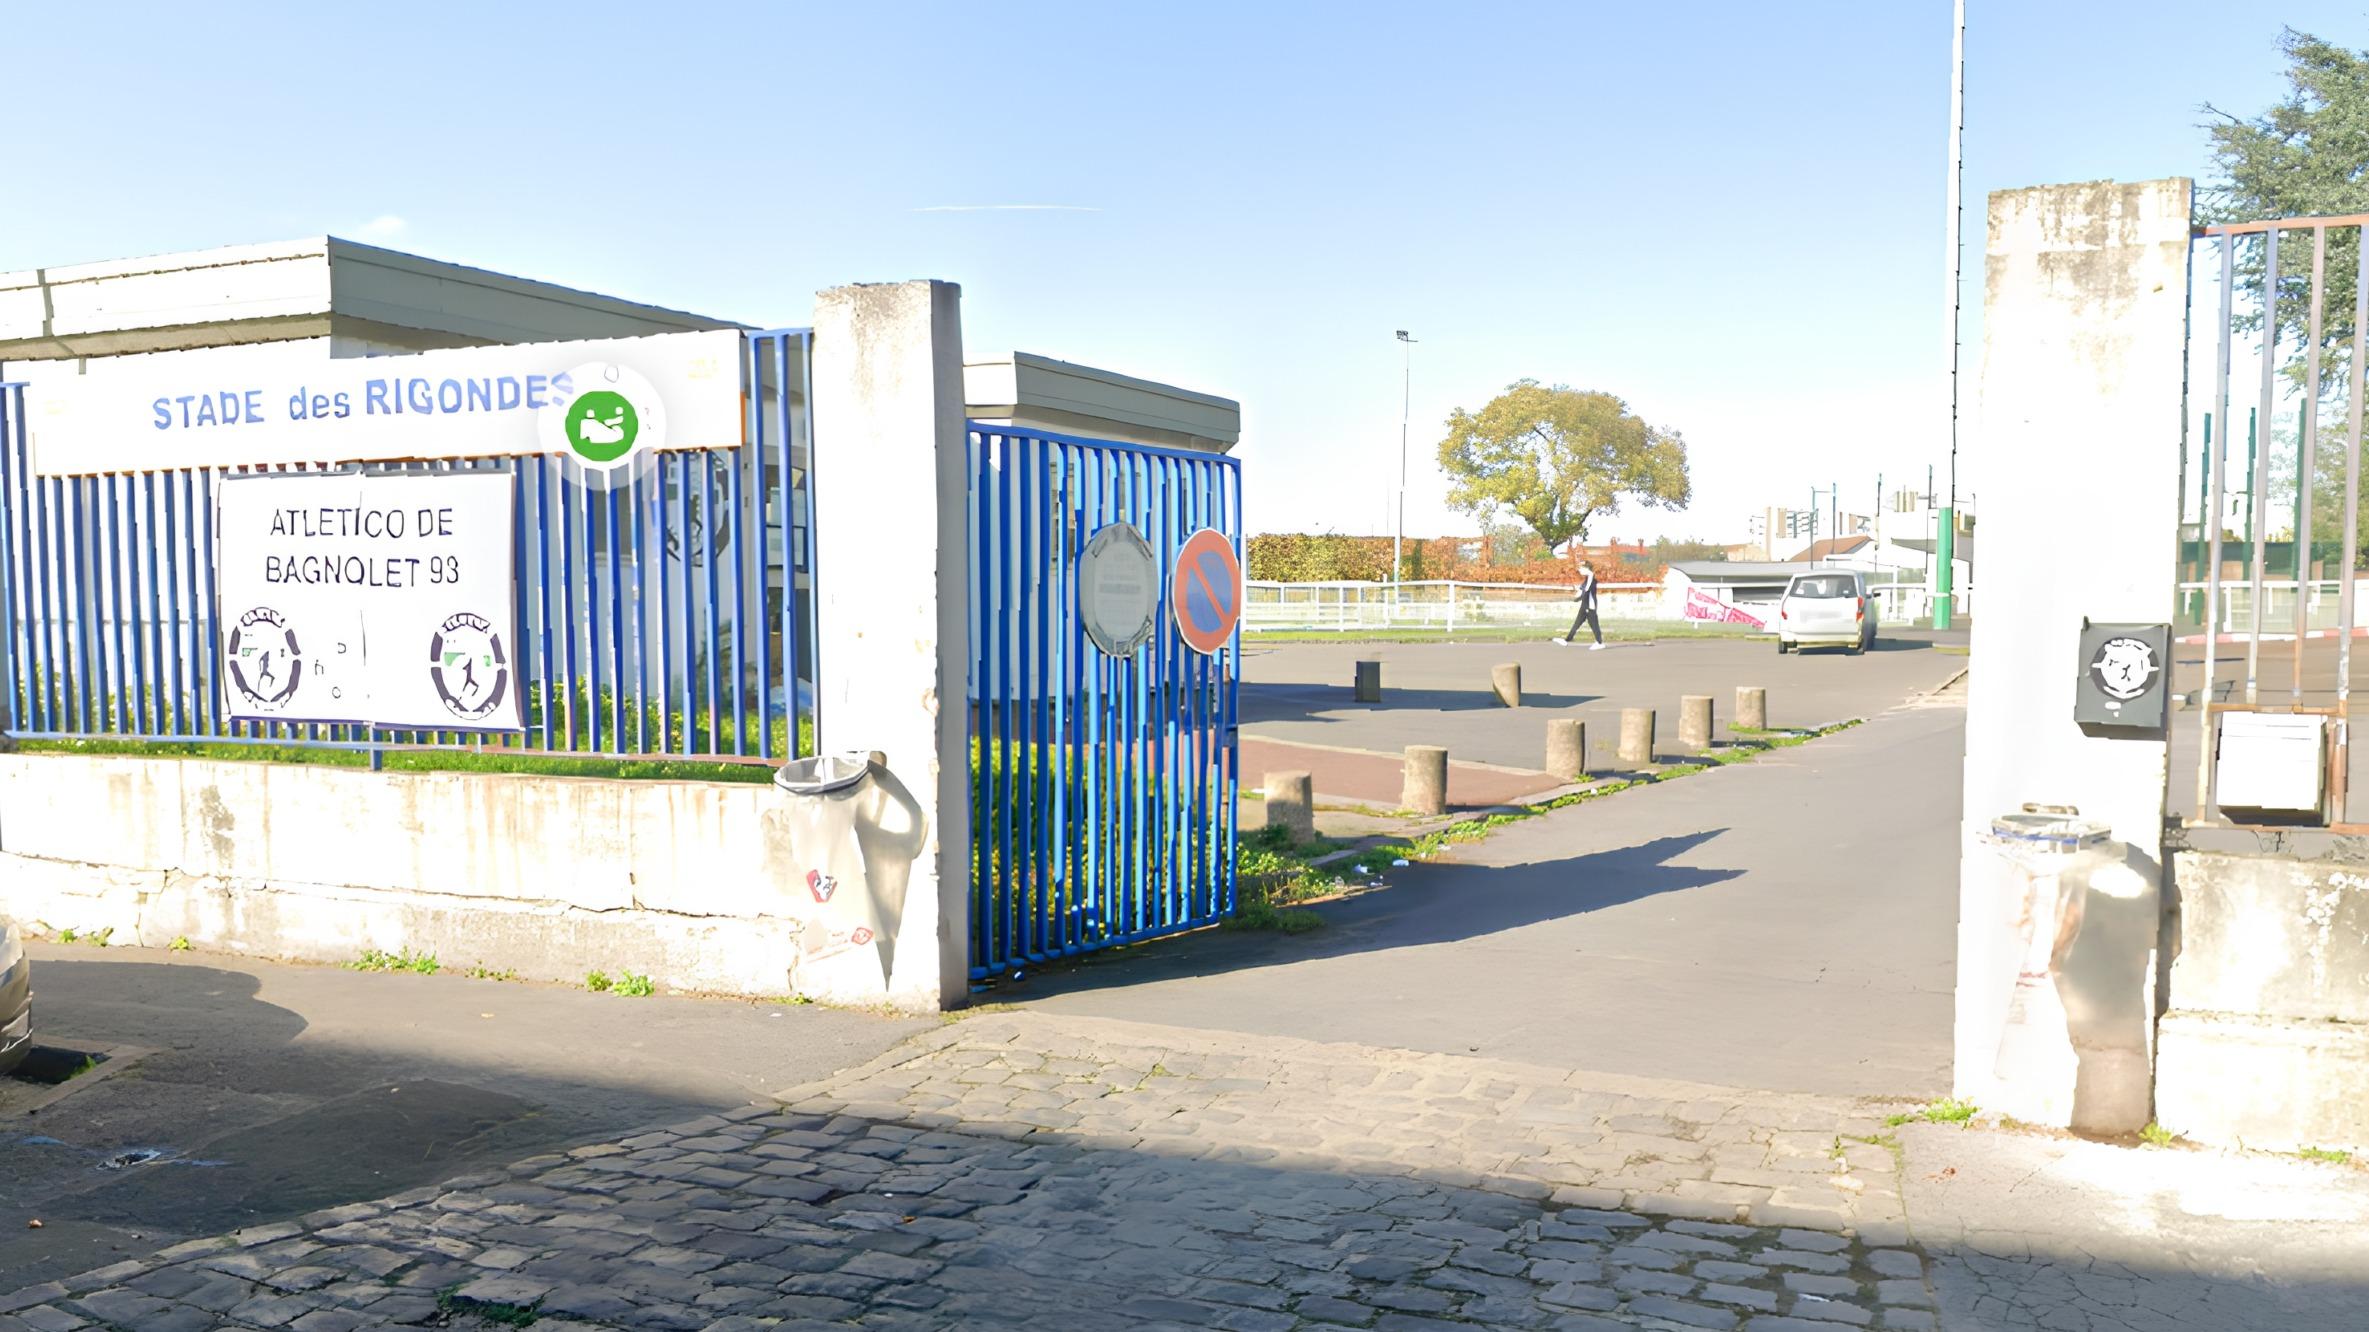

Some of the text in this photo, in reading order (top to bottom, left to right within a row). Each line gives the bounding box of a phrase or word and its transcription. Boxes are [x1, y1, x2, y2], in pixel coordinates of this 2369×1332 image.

[152, 390, 265, 430] STADE
[289, 386, 350, 421] des
[270, 508, 453, 538] ATLETICO DE
[266, 555, 459, 587] BAGNOLET 93
